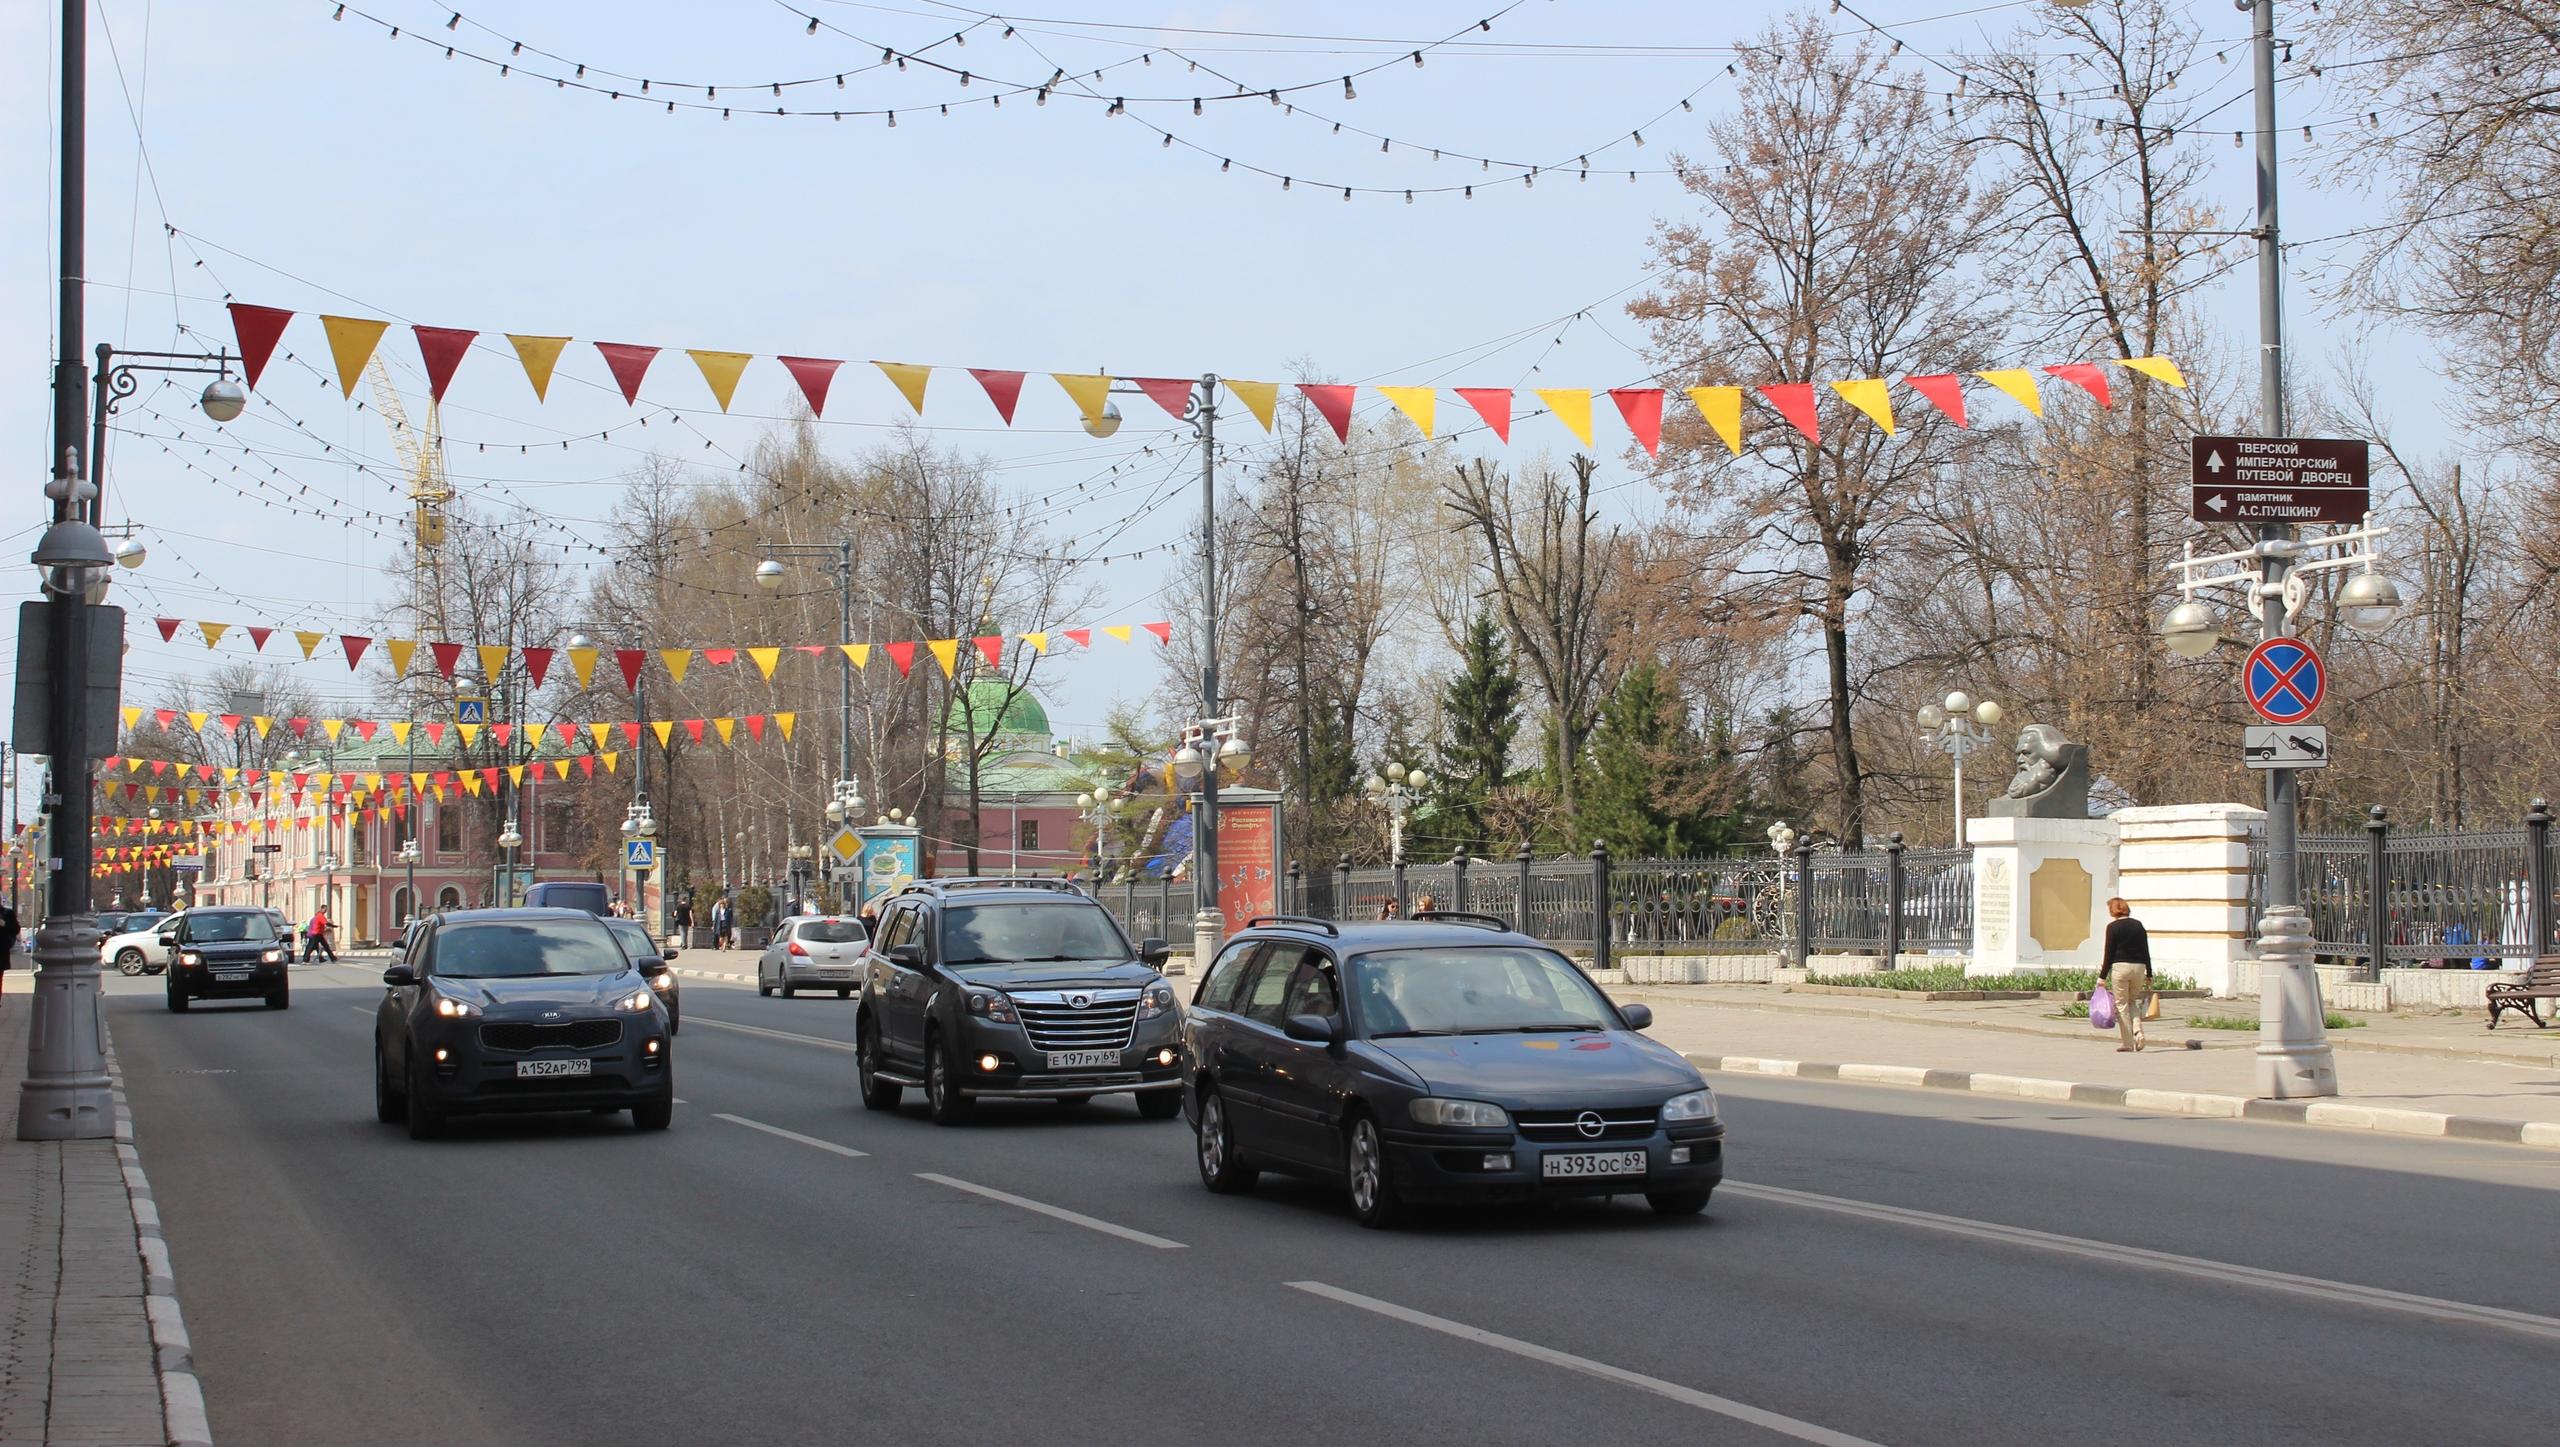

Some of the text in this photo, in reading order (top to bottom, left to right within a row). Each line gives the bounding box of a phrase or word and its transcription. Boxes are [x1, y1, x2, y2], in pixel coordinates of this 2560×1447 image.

[2237, 442, 2299, 455] ТВЕРСКОЙ
[2236, 456, 2337, 470] ИМПЕРАТОРСКИЙ
[2236, 469, 2352, 486] ПУТЕВОЙ ДВОРЕЦ
[2237, 493, 2293, 502] памятник
[2238, 505, 2321, 517] А.С.ПУШКИНУ
[1103, 1050, 1116, 1061] 69
[1624, 1152, 1641, 1167] 69
